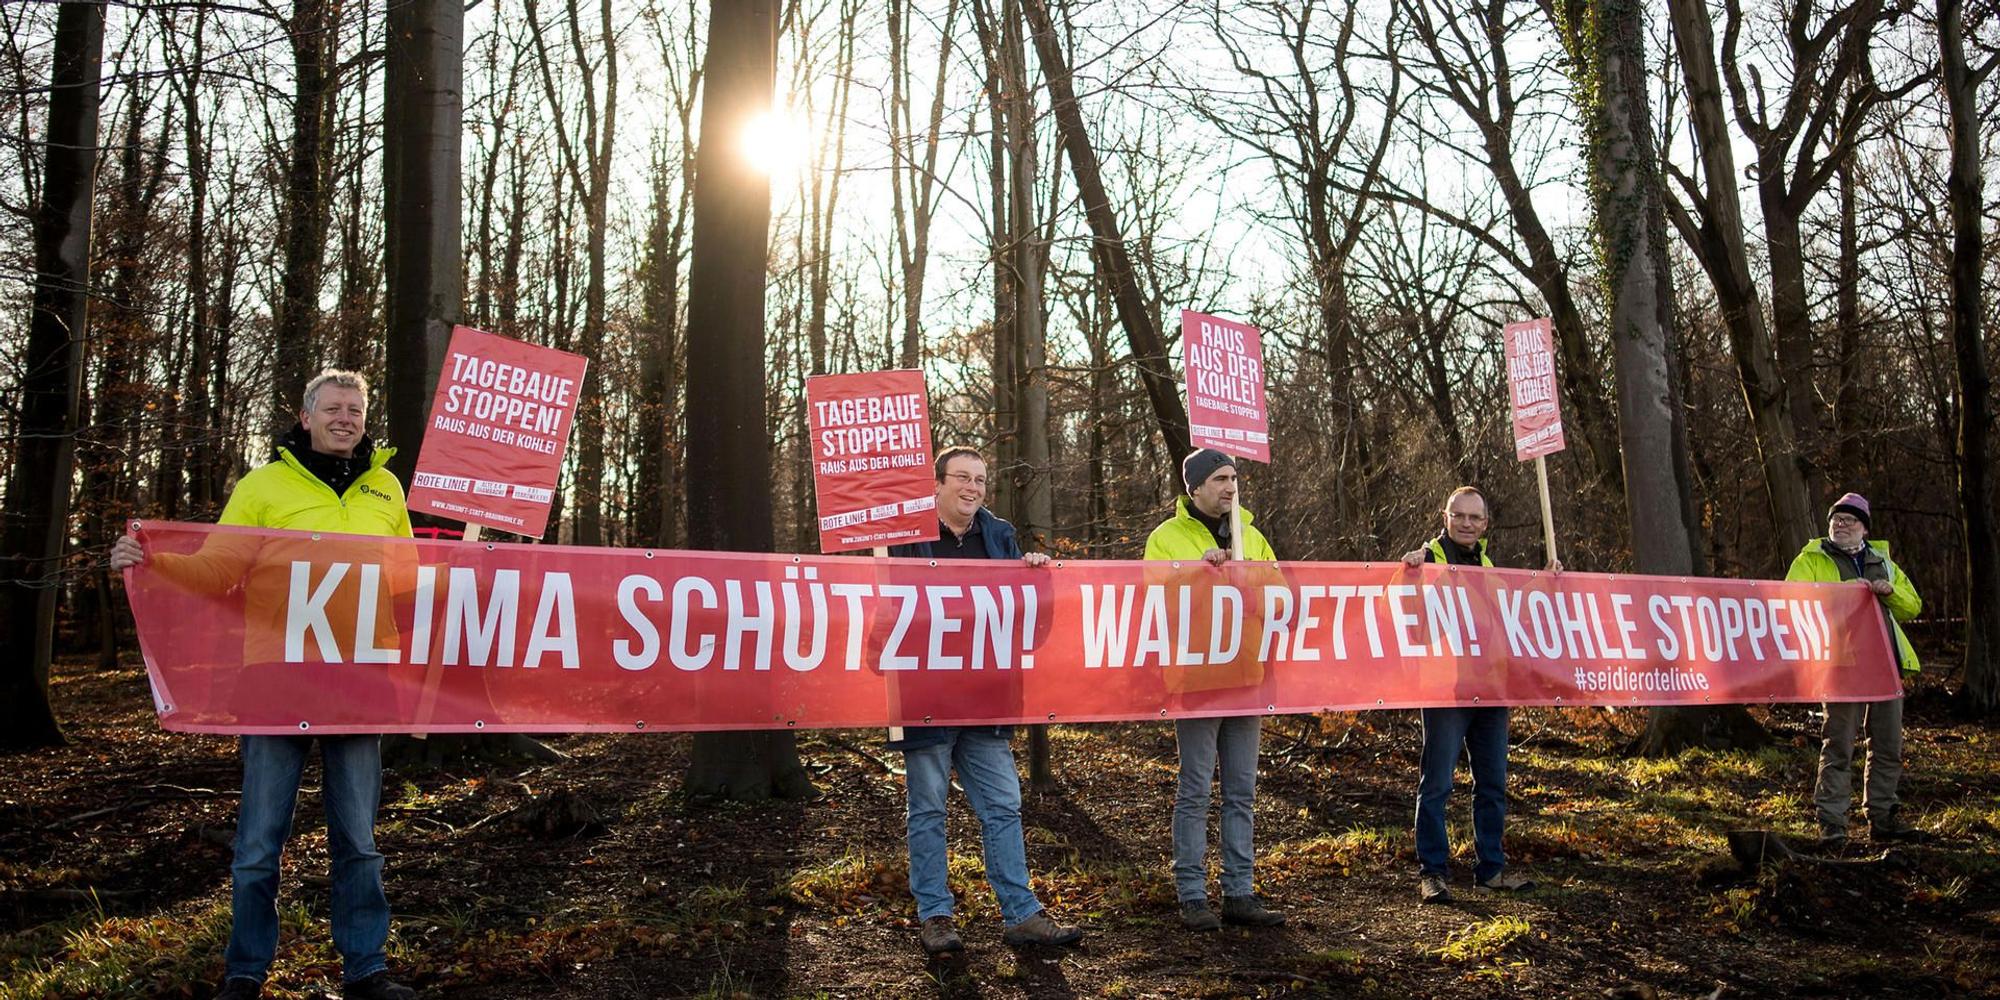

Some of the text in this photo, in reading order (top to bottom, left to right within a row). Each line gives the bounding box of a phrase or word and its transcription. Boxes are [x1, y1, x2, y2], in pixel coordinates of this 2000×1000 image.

[1201, 321, 1245, 355] RAUS
[1515, 328, 1543, 355] RAUS
[451, 352, 573, 407] TAGEBAUE
[1190, 343, 1259, 383] AUS DER
[1510, 351, 1552, 382] AUS DER
[1196, 368, 1257, 407] KOHLE!
[445, 385, 562, 436] STOPPEN!
[815, 394, 922, 427] TAGEBAUE
[1195, 395, 1260, 421] TAGEBAUE STOPPEN!
[435, 415, 557, 456] RAUS AUS DER KOHLE!
[821, 422, 922, 457] STOPPEN!
[820, 453, 926, 475] RAUS AUS DER KOHLE!
[370, 489, 392, 502] BUND
[416, 474, 441, 489] ROTE
[442, 477, 468, 492] LINIE
[823, 515, 843, 529] ROTE
[844, 511, 865, 525] LINIE
[285, 560, 1831, 672] KLIMA SCHÜTZEN! WALD RETTEN! KOHLE STOPPEN!
[1574, 665, 1709, 692] #seidierotelinie
